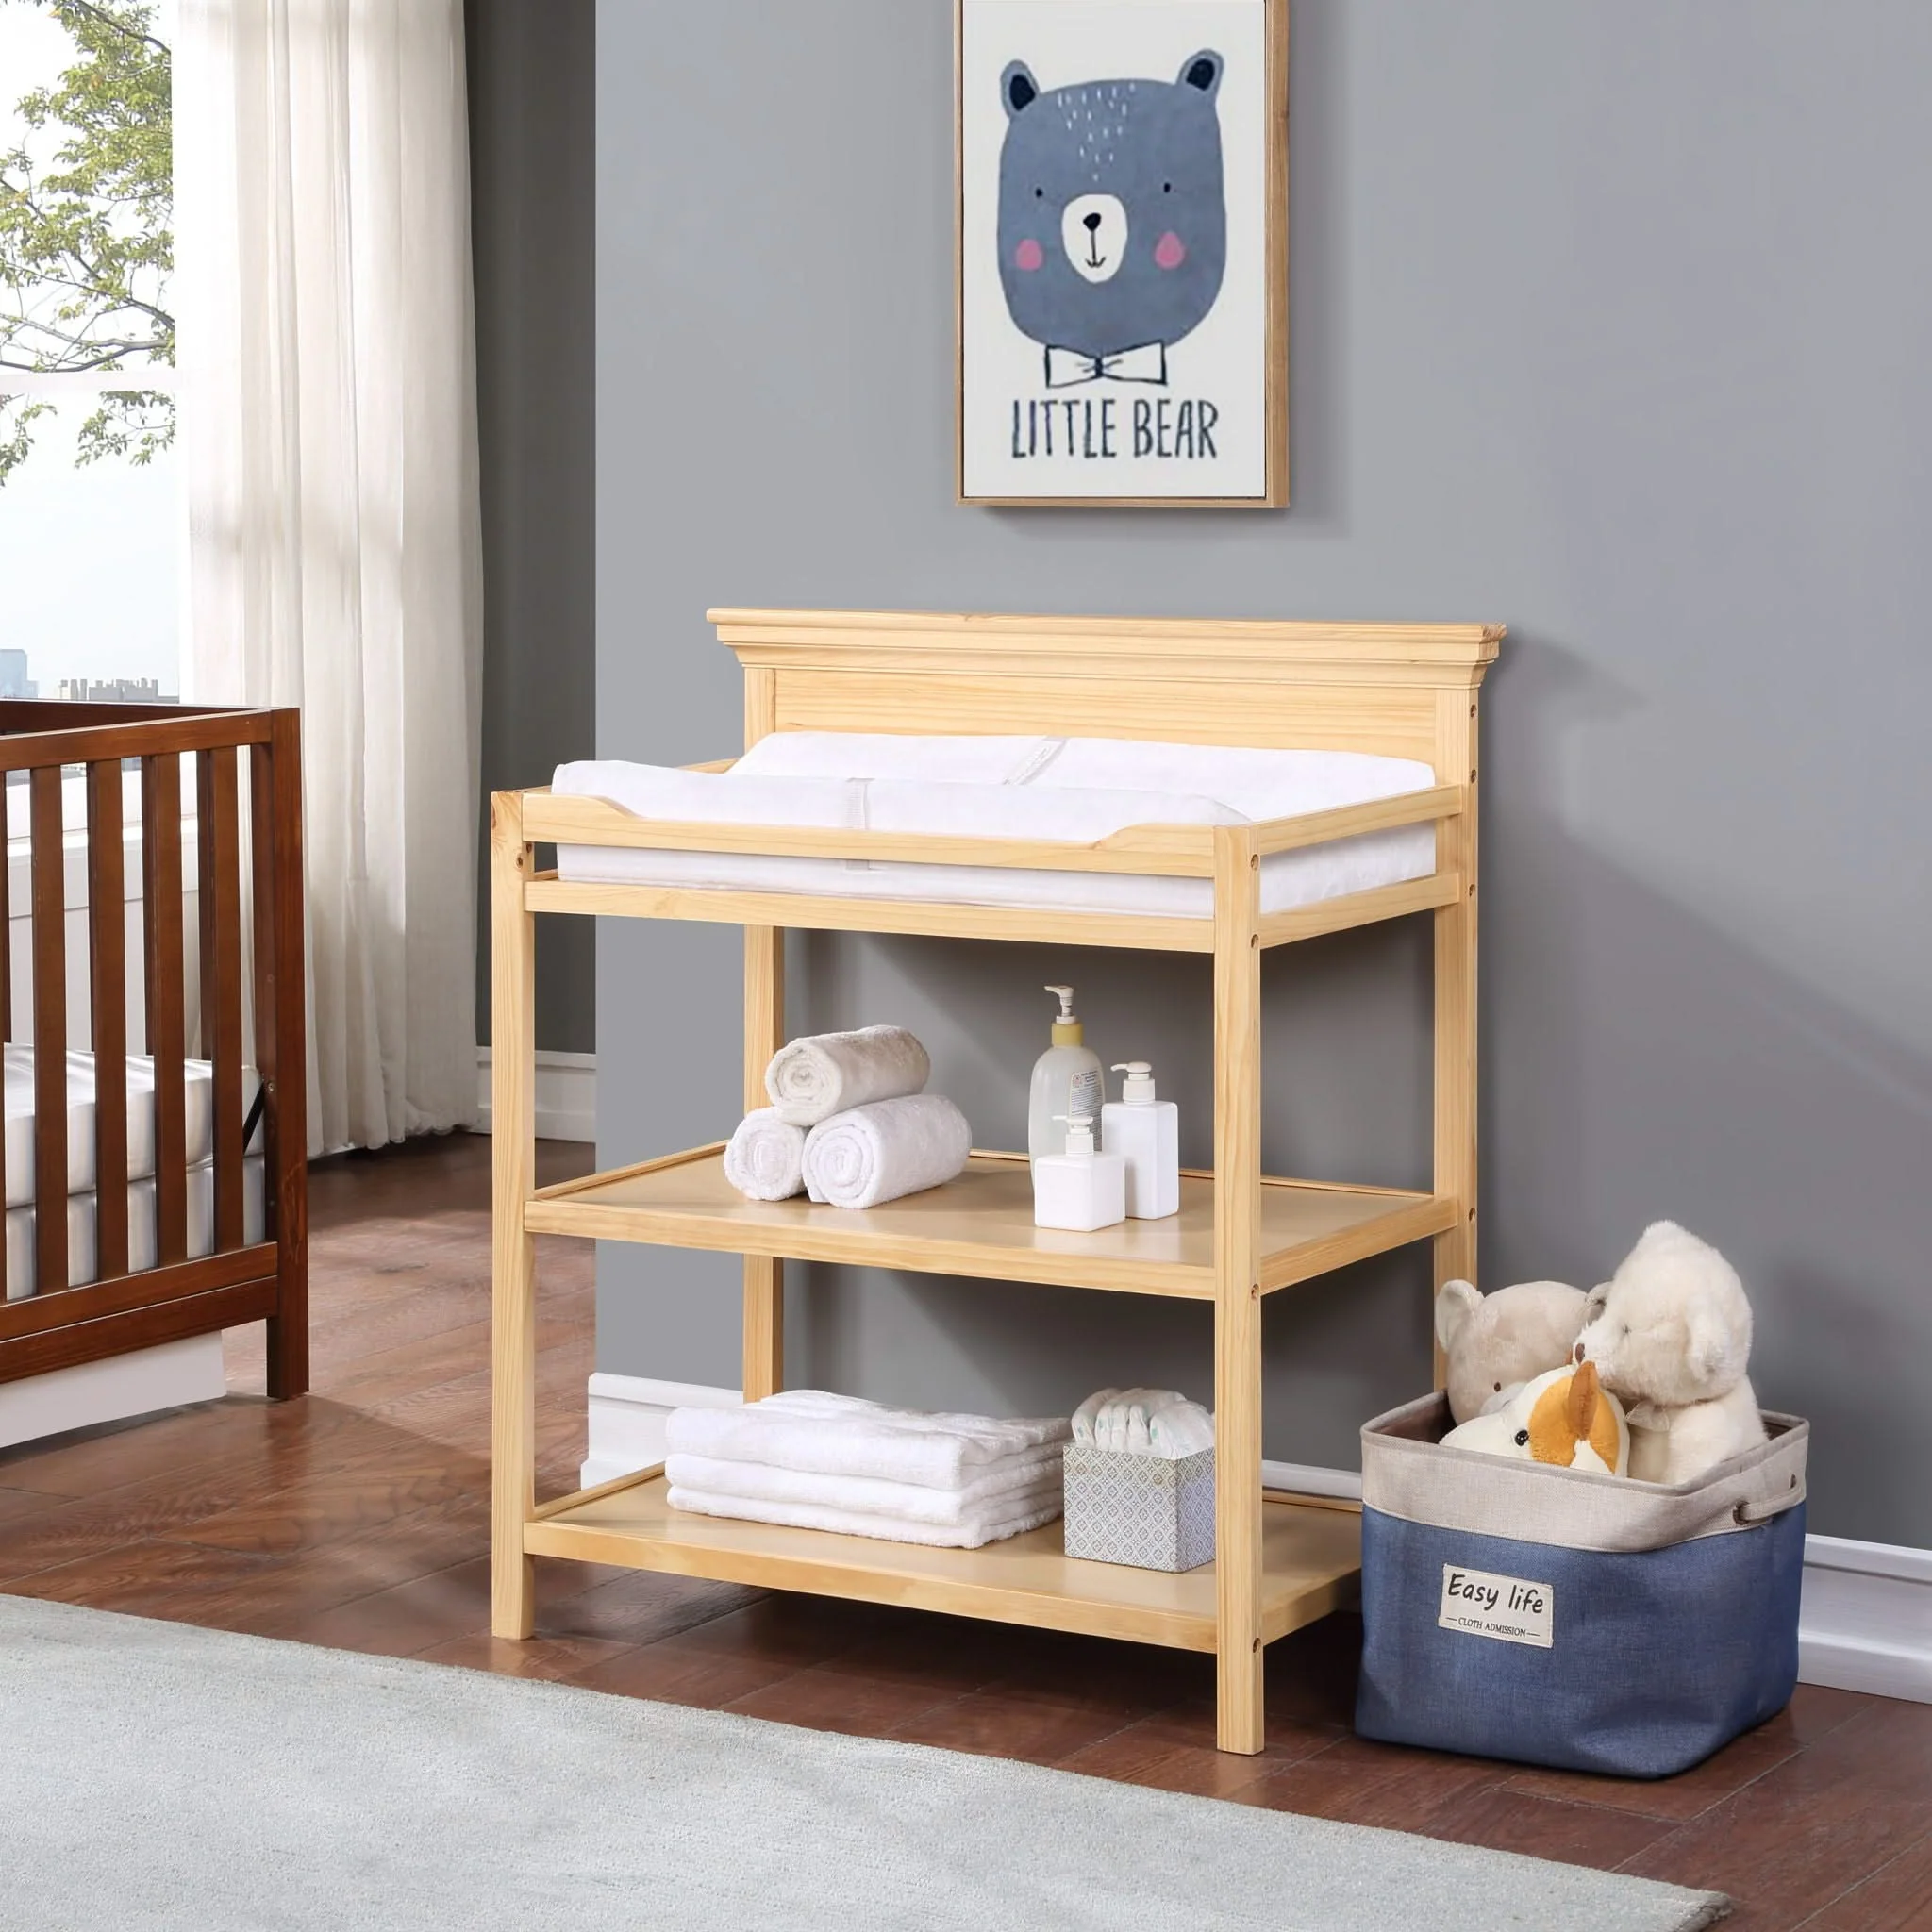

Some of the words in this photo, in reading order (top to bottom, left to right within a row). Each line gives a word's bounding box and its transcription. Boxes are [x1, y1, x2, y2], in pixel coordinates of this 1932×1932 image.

[1012, 399, 1117, 458] LITTLE
[1133, 399, 1218, 458] BEAR
[1448, 1573, 1499, 1611] Easy
[1508, 1585, 1543, 1613] life
[1458, 1617, 1483, 1629] CLOTH
[1485, 1623, 1526, 1637] ADMISSION
